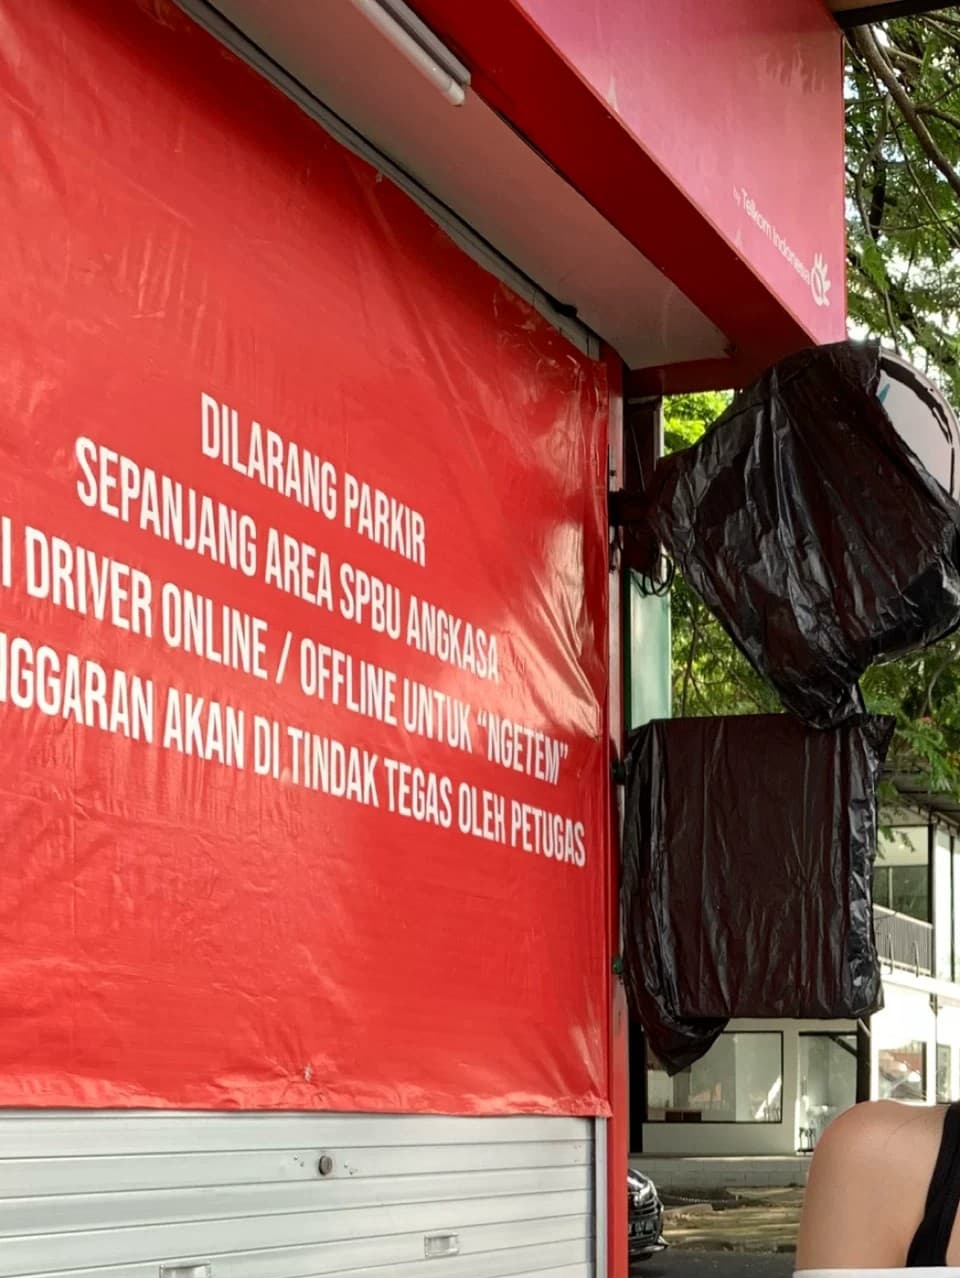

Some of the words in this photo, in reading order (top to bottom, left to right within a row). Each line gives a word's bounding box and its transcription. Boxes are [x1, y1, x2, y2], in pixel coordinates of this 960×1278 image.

[741, 187, 773, 241] Telkom
[772, 226, 812, 286] Indonesia
[75, 435, 258, 577] SEPANJANG
[264, 527, 334, 612] AREA
[338, 562, 401, 641] SPBU
[406, 595, 499, 681] ANGKASA
[201, 391, 337, 521] DILARANG
[344, 471, 426, 568] PARKIR
[25, 525, 153, 639] DRIVER
[162, 582, 268, 681] ONLINE
[275, 631, 293, 685] /
[300, 638, 398, 727] OFFLINE
[403, 678, 473, 754] UNTUK
[163, 687, 244, 770] AKAN
[253, 715, 279, 780] DI
[287, 726, 380, 808] TINDAK
[384, 758, 453, 829] TEGAS
[458, 782, 506, 845] OLEH
[511, 800, 586, 868] PETUGAS
